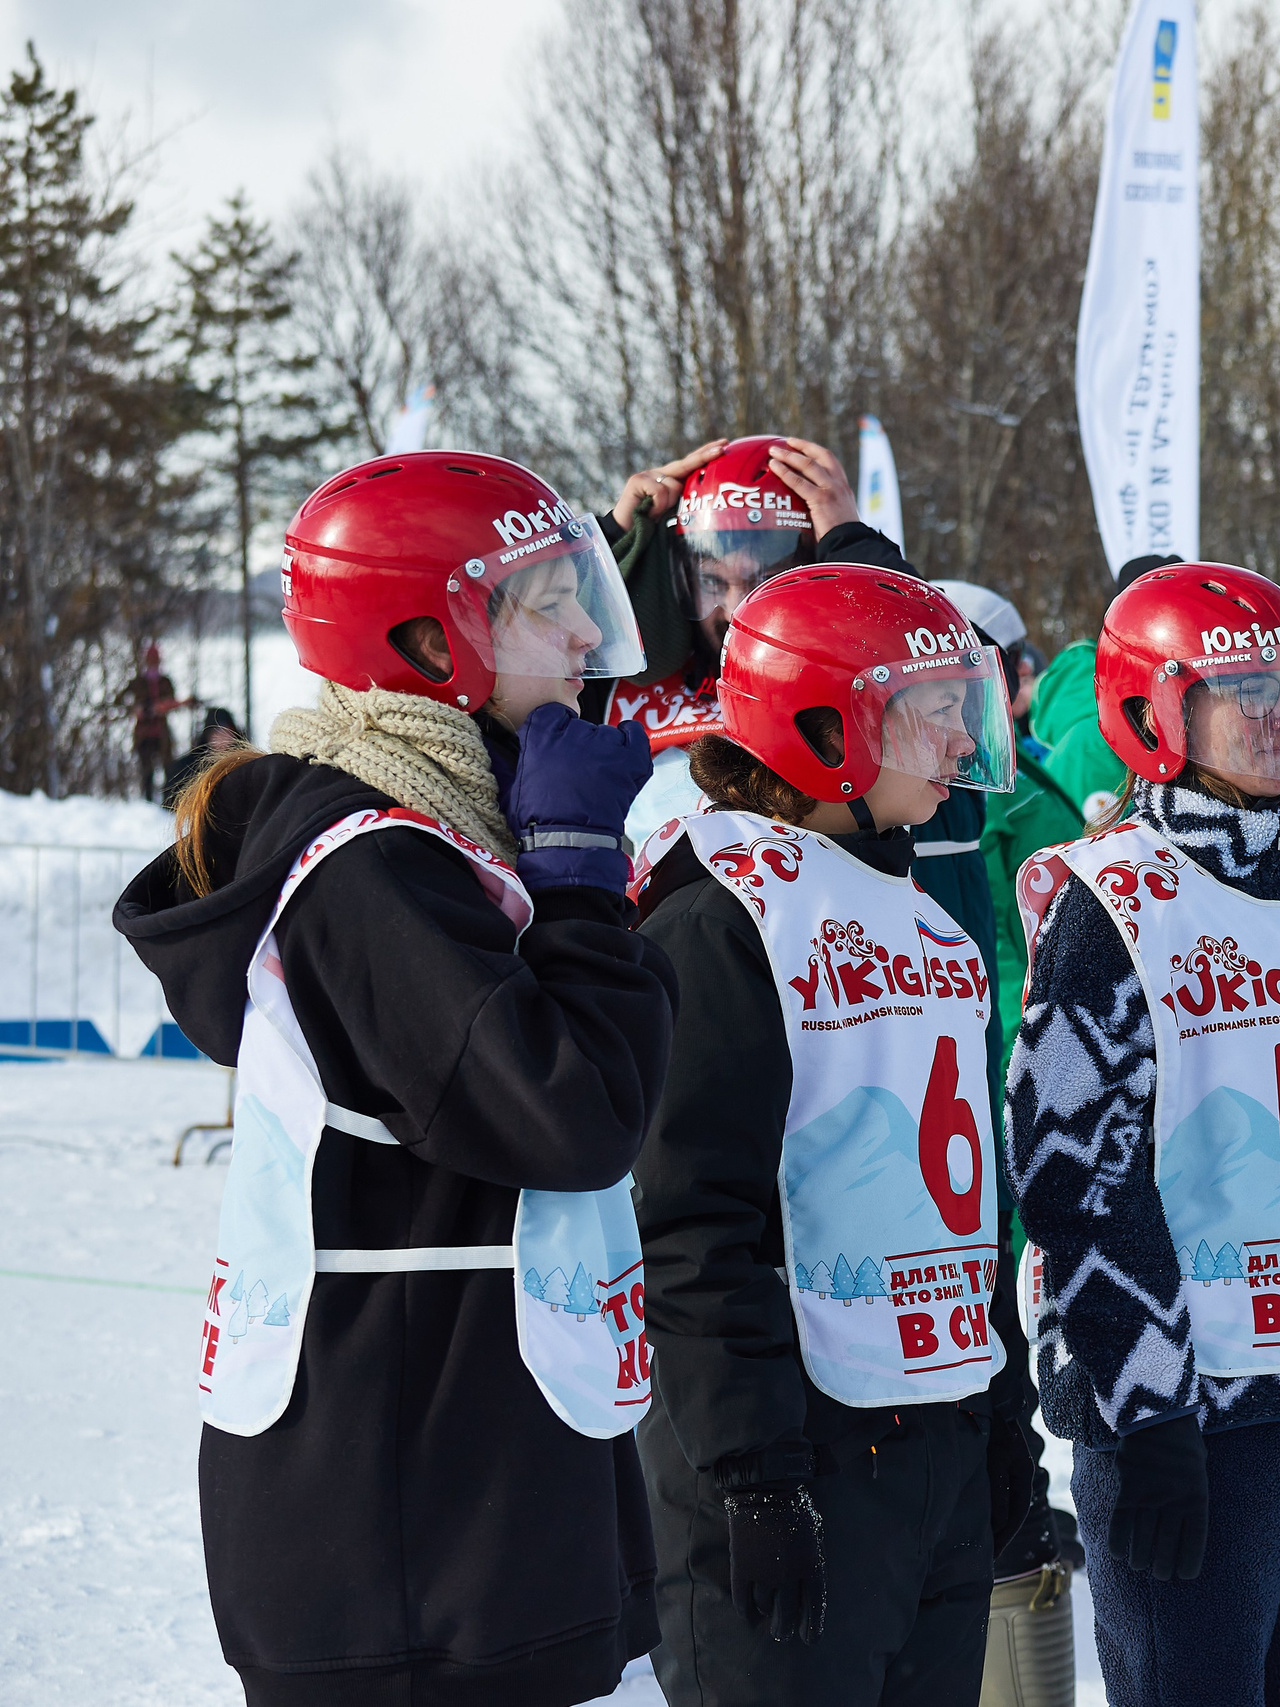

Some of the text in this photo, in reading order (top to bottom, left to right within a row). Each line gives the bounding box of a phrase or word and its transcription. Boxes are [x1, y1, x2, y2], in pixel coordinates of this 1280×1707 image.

[499, 532, 563, 565] МУРМАНСК
[902, 656, 961, 674] МУРМАНСК
[1192, 653, 1252, 669] МУРМАНСК
[894, 1005, 924, 1016] REGION
[1201, 1018, 1257, 1035] MURMANSK
[918, 1035, 982, 1236] 6
[890, 1266, 938, 1291] ДЛЯ
[892, 1288, 932, 1308] КТО
[896, 1312, 940, 1360] В
